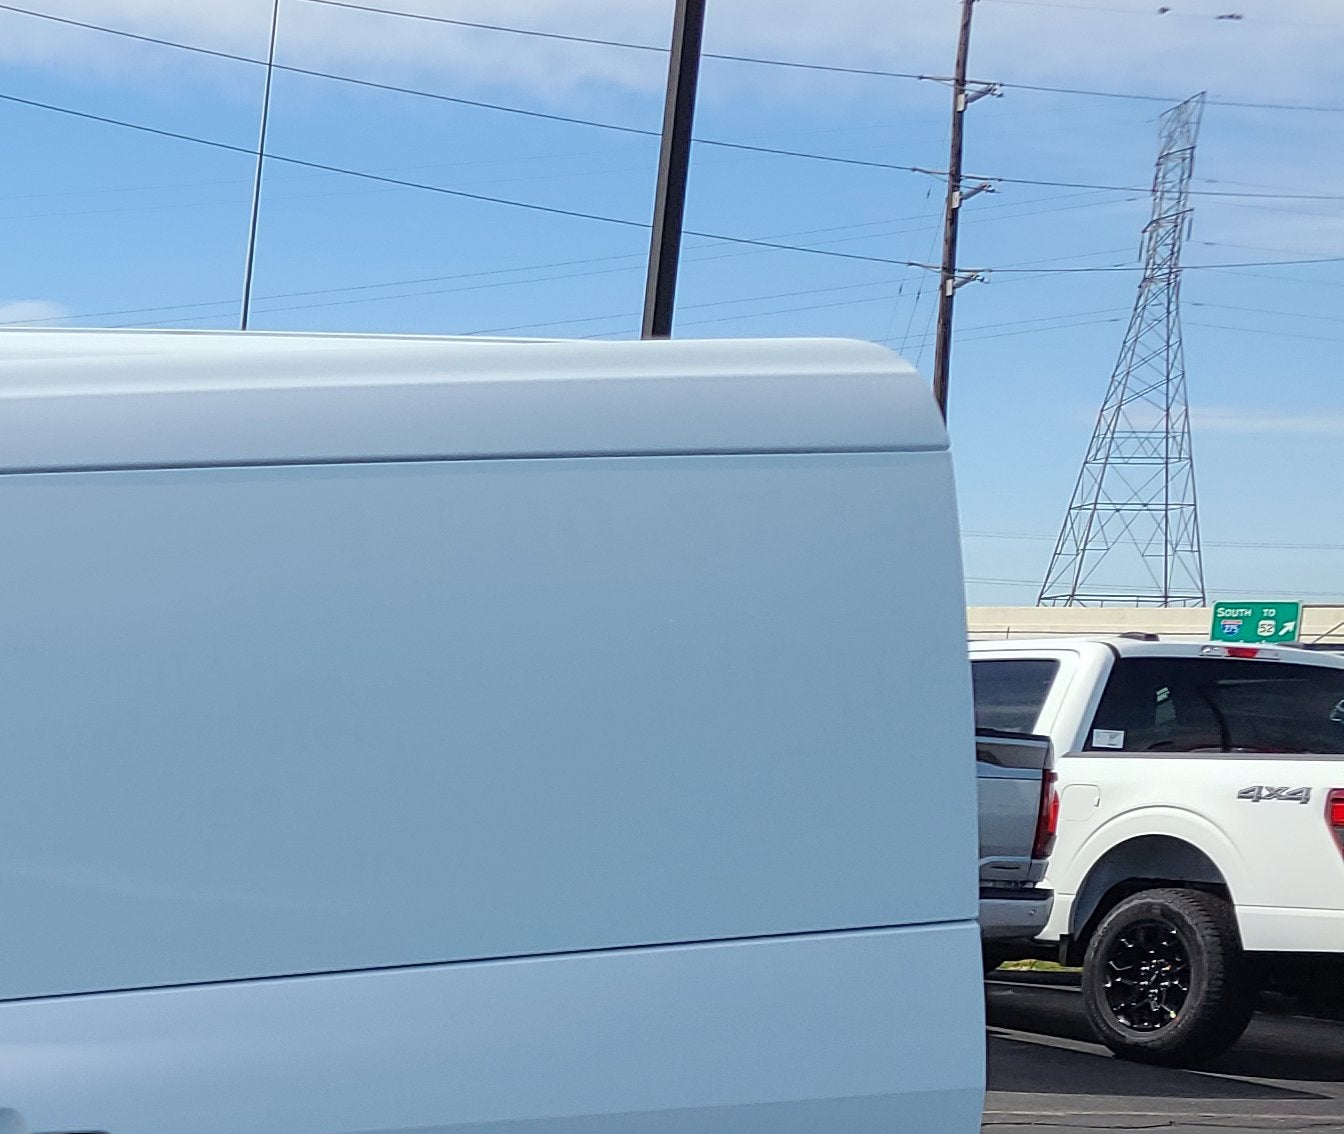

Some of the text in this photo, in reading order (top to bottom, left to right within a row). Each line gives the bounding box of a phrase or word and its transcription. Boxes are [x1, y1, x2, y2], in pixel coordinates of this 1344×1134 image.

[1216, 607, 1277, 618] SOUTH TO
[1223, 623, 1274, 633] 275 52
